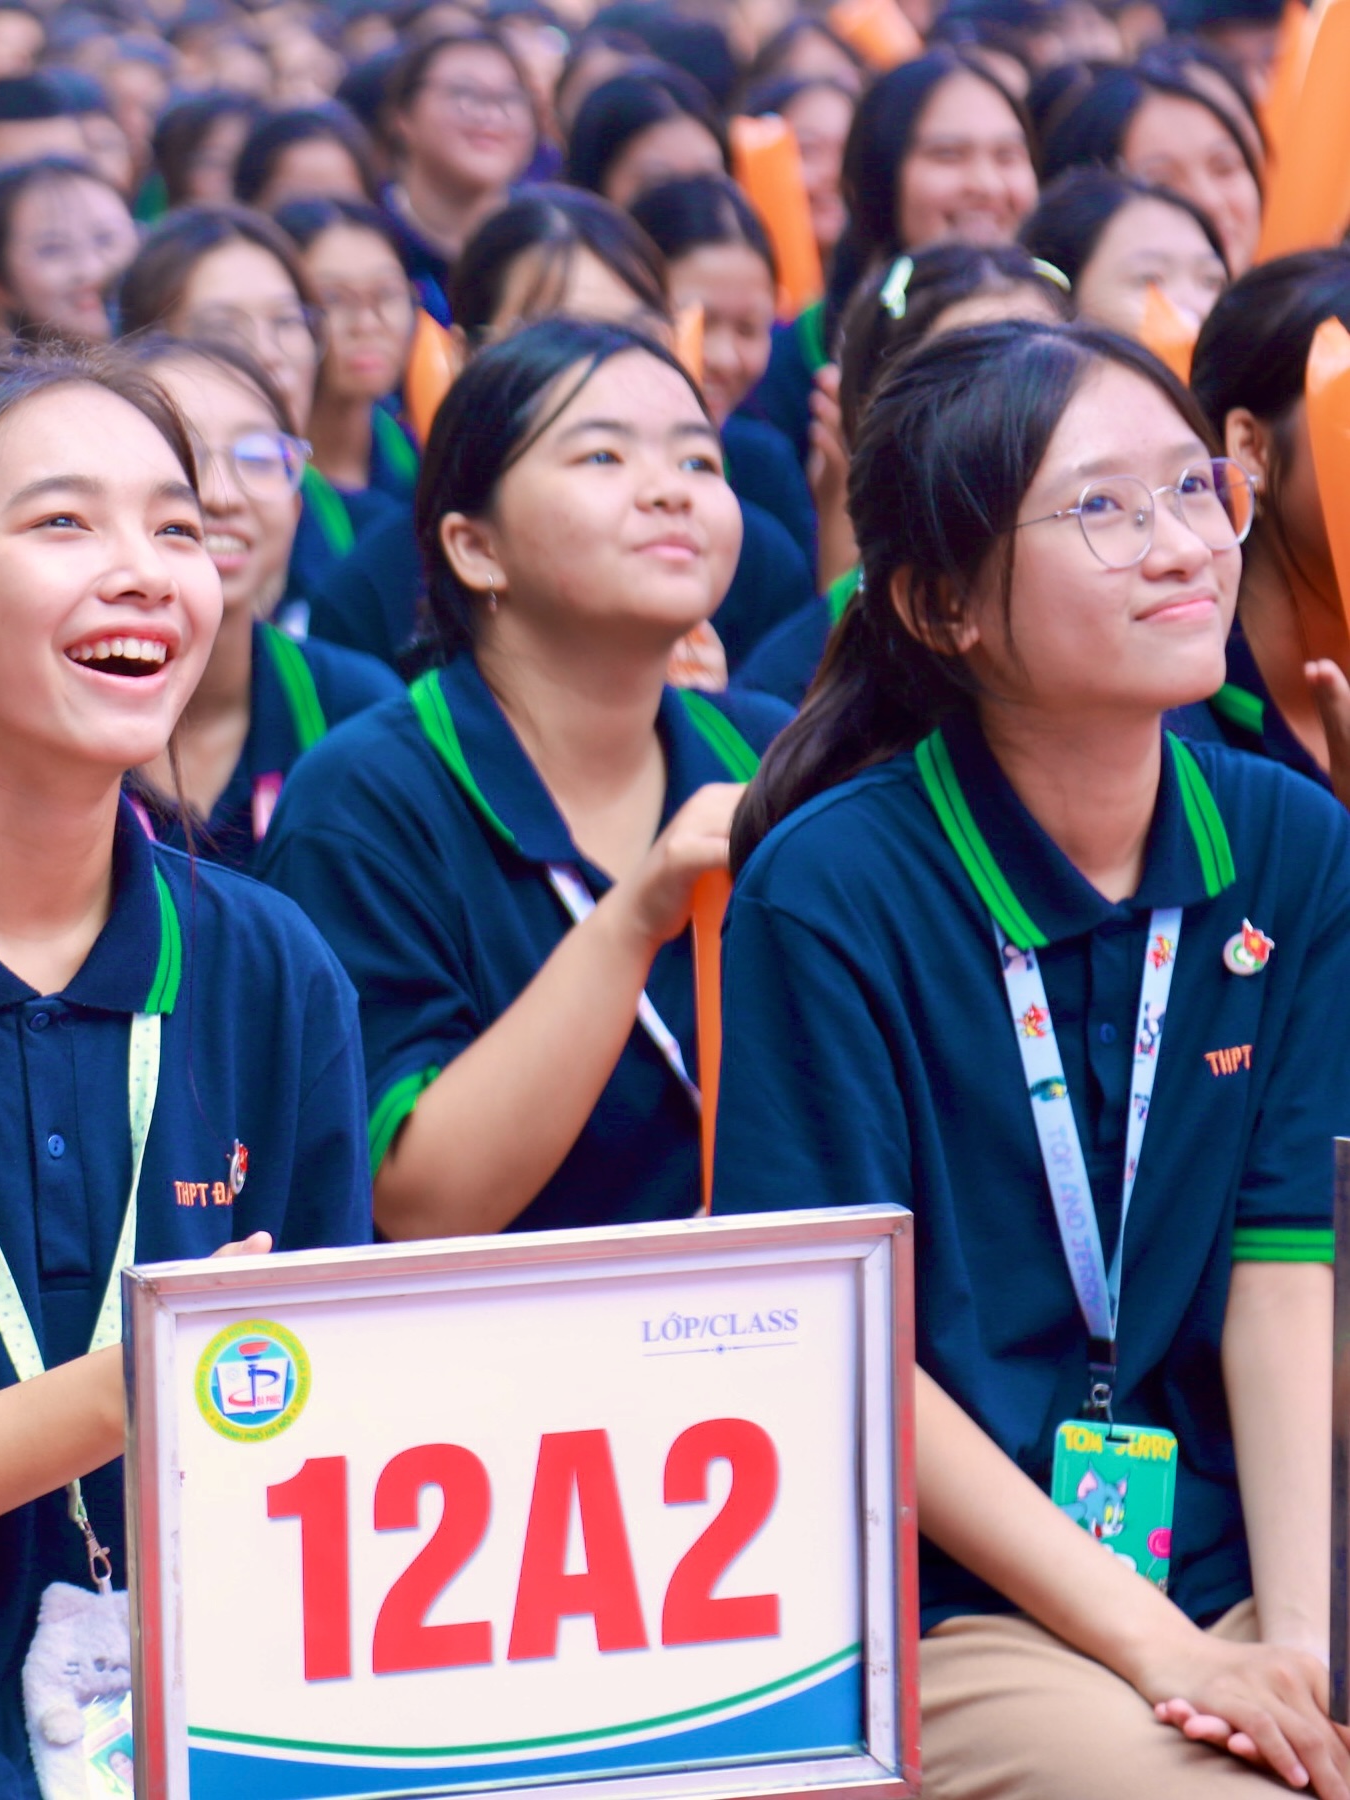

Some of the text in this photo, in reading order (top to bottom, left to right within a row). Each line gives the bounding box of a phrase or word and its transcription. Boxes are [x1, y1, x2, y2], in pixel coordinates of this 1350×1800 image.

[1203, 1044, 1252, 1077] THPT
[173, 1181, 209, 1207] THPT
[641, 1308, 800, 1343] LỚP/CLASS
[1059, 1425, 1103, 1454] TOM
[265, 1415, 782, 1684] 12A2
